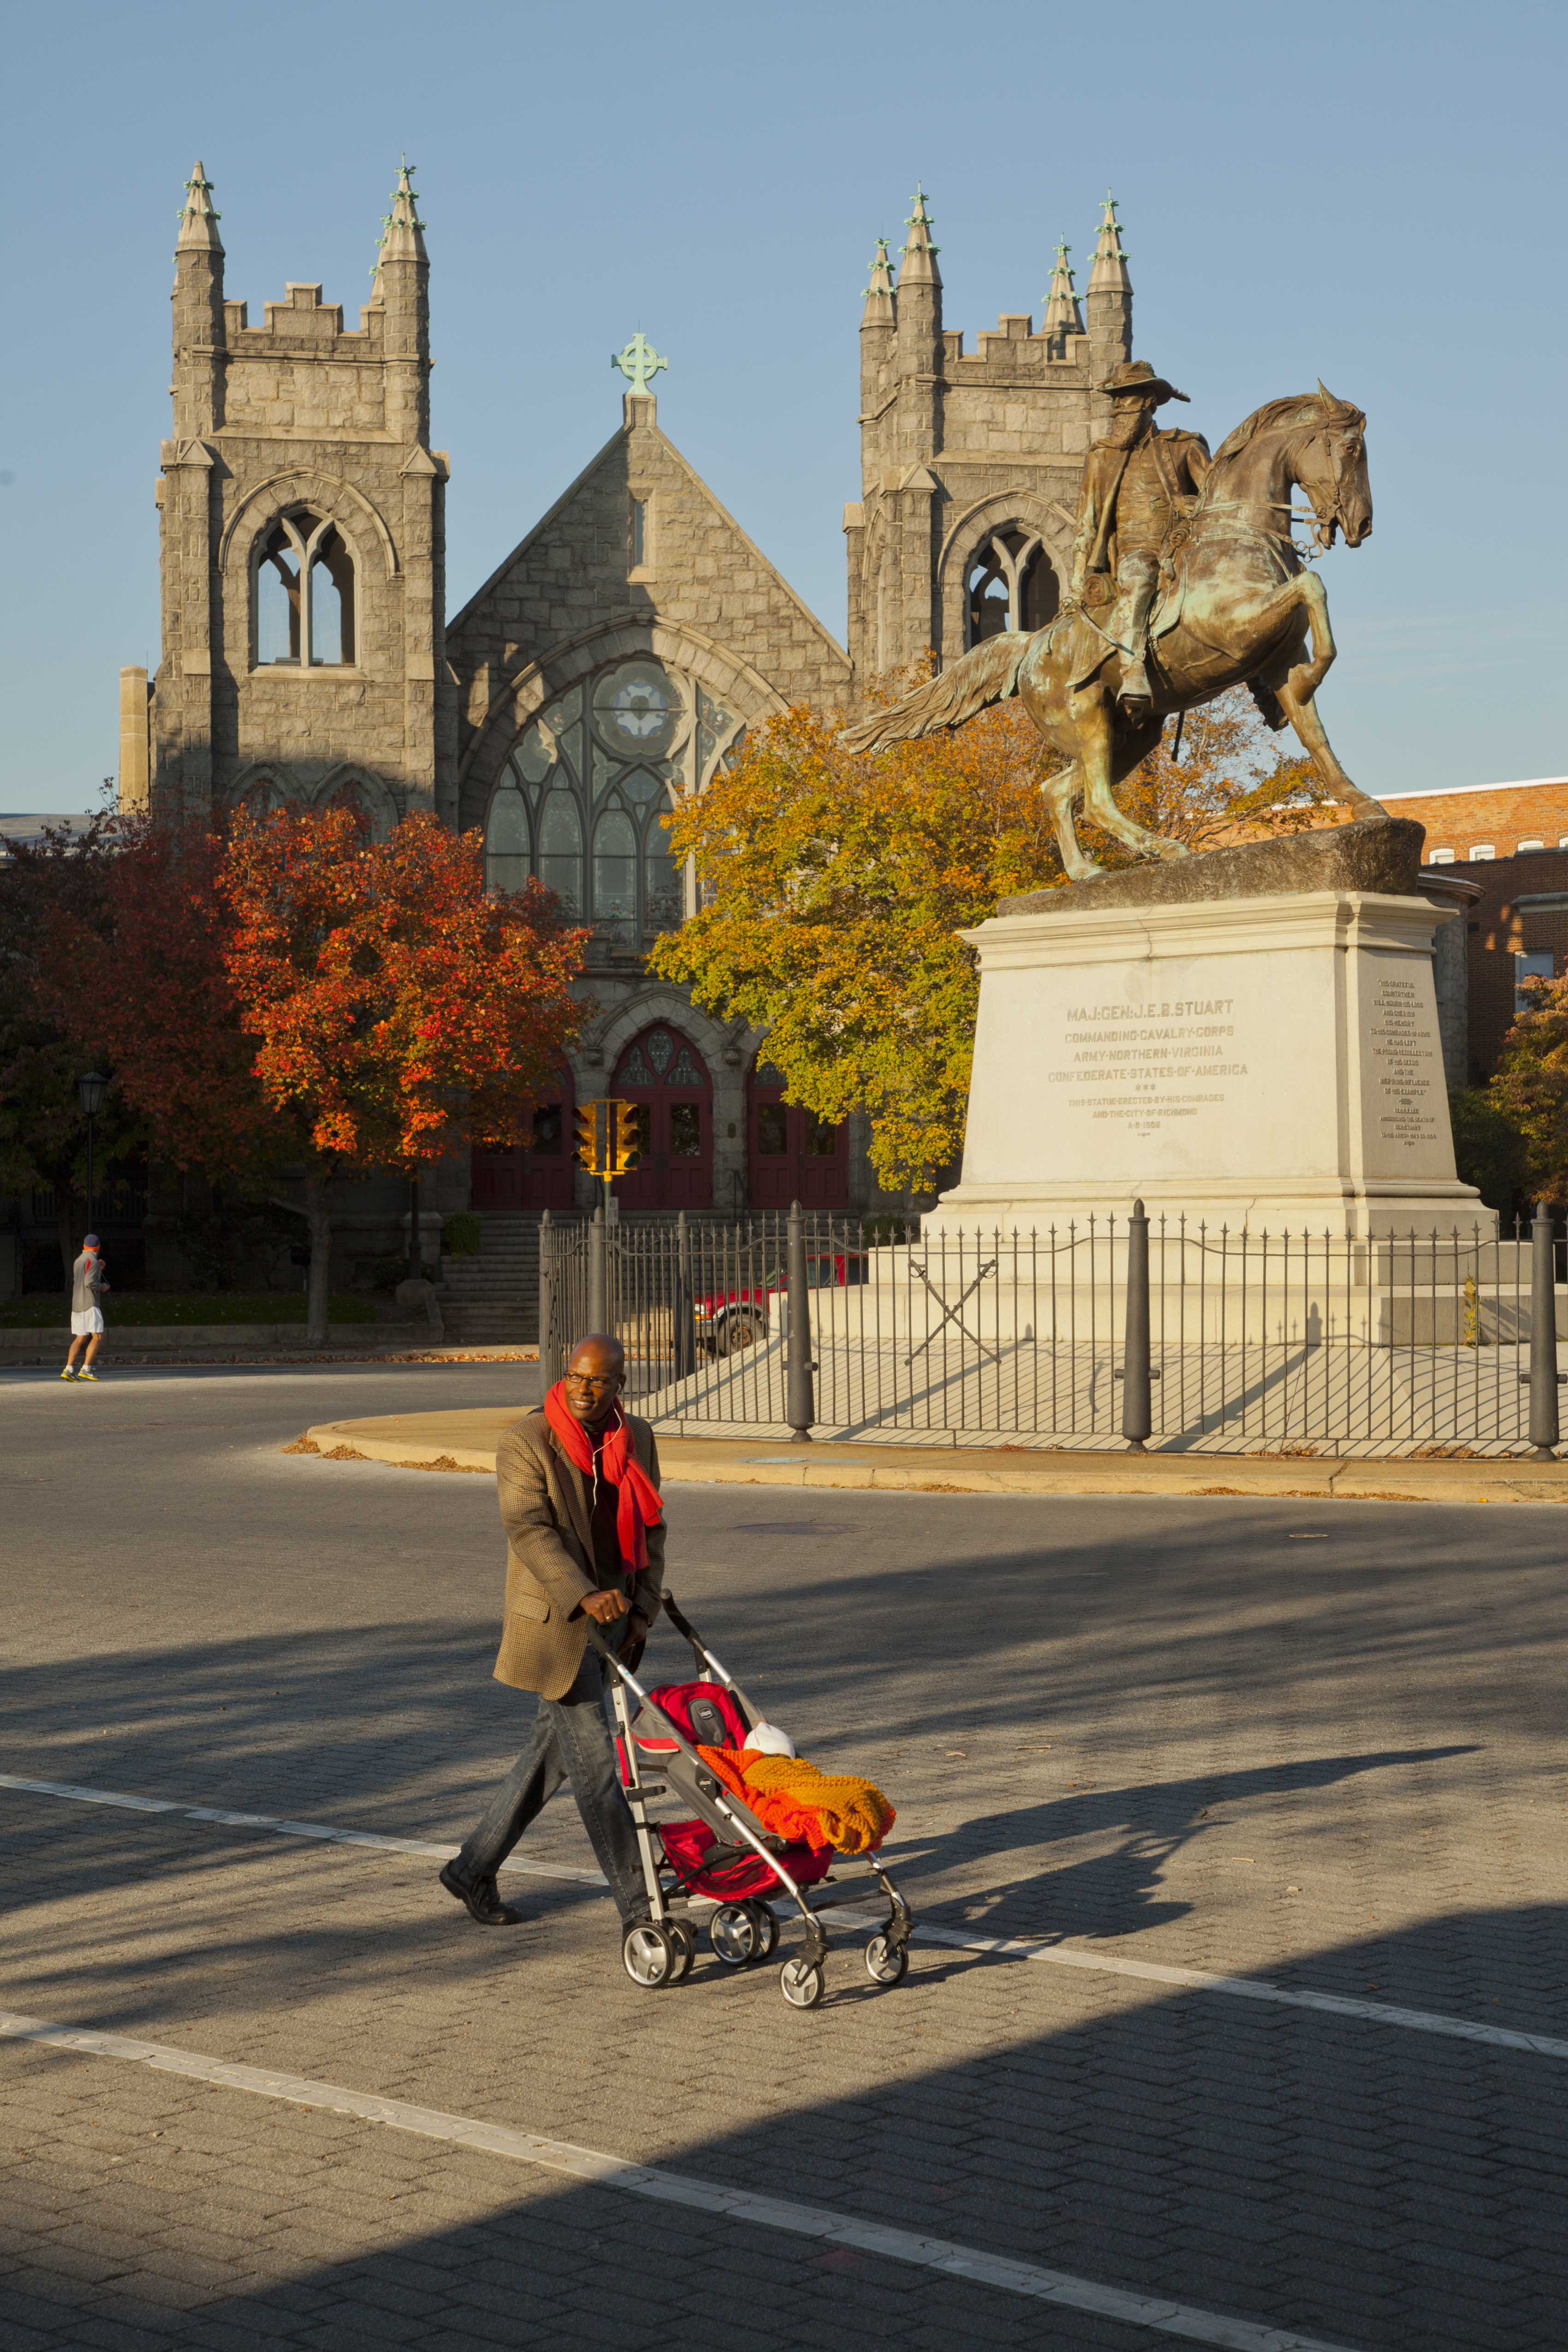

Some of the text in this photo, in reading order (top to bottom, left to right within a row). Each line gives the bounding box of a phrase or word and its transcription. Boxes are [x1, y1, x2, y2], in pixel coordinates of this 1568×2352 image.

[1175, 999, 1234, 1016] STUART
[1065, 1025, 1234, 1044] COMMANDING CAVALRY CORPS
[1073, 1045, 1224, 1063] ARMY NORTHERN VIRGINIA
[1048, 1063, 1248, 1083] CONFEDERATE STATES OF AMERICA
[1118, 1097, 1152, 1105] ERECTED
[1182, 1094, 1224, 1103] COMRADES
[1158, 1108, 1198, 1116] RICHMOND
